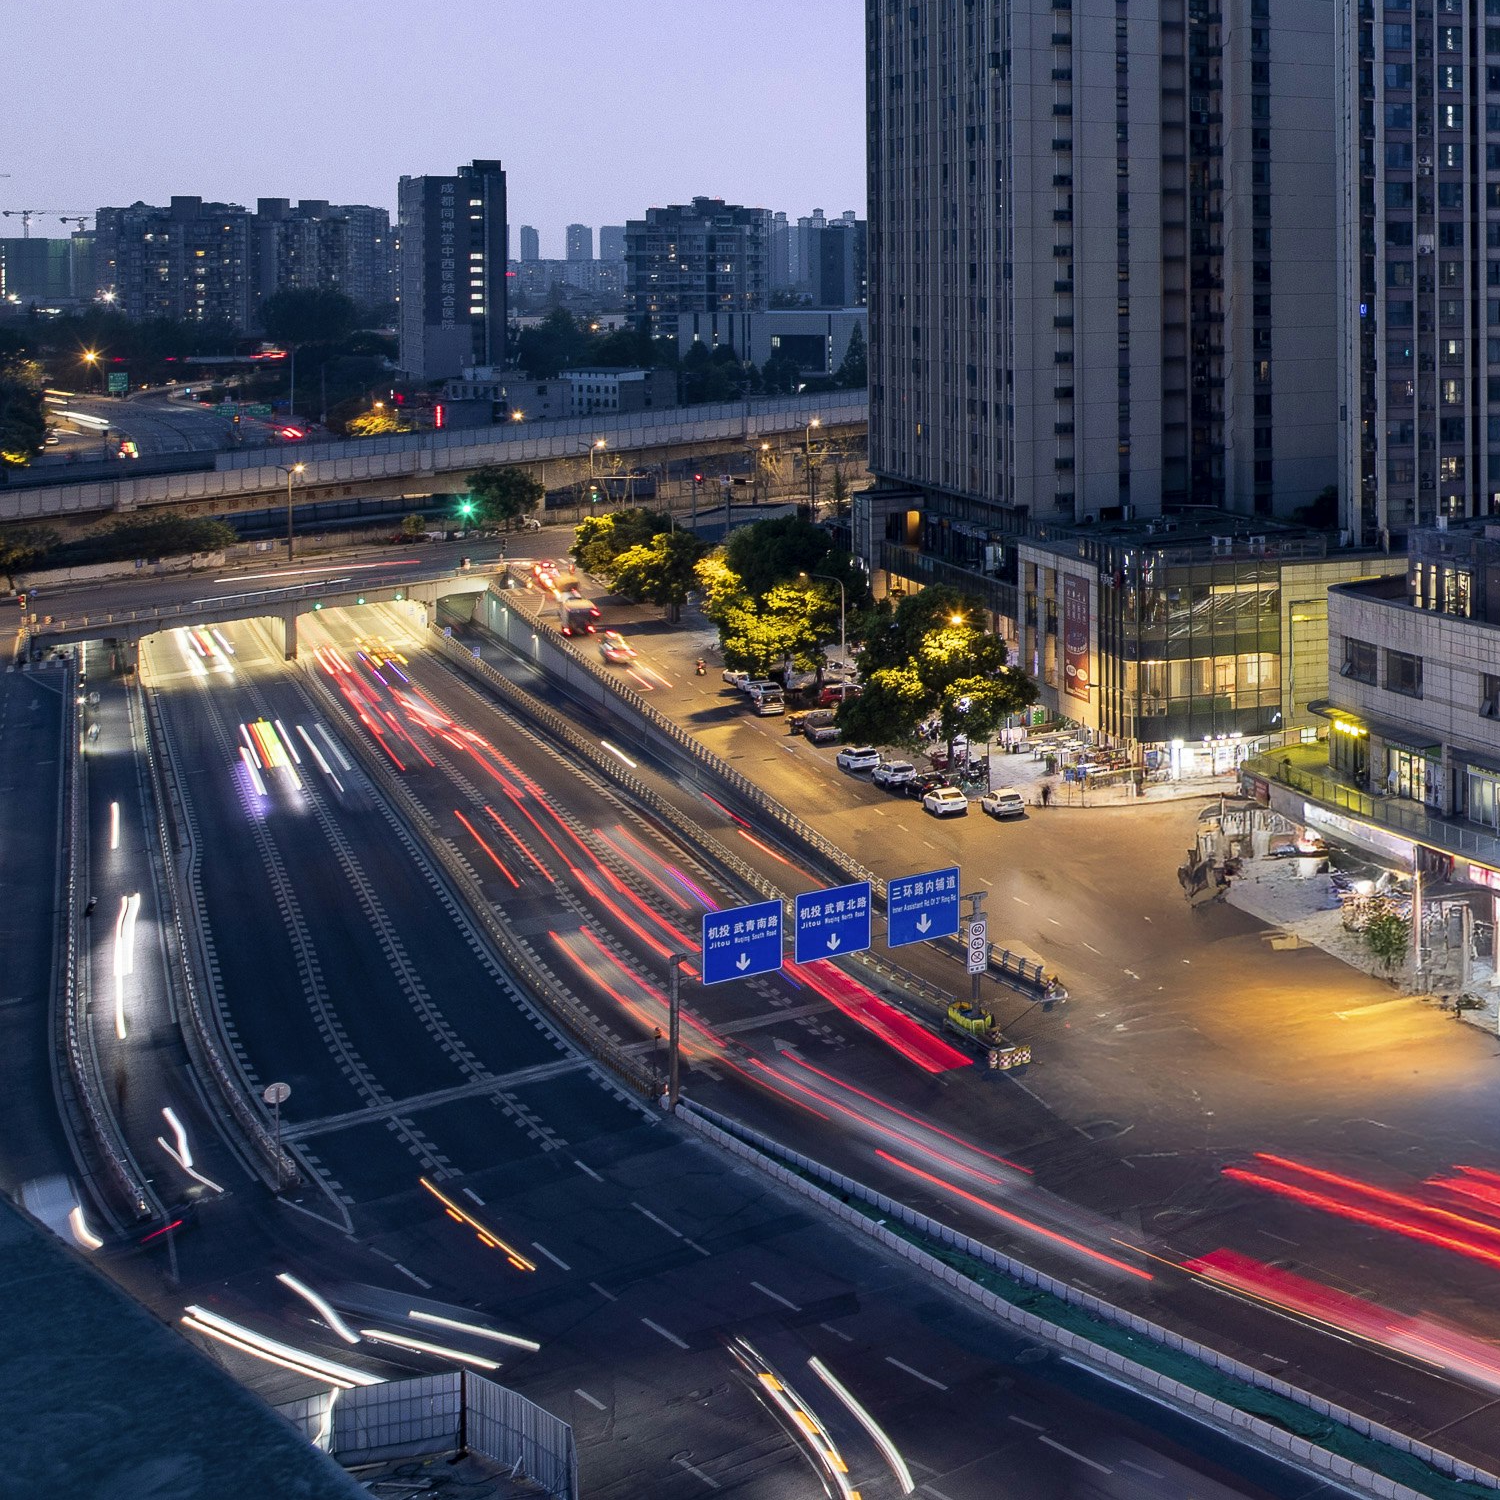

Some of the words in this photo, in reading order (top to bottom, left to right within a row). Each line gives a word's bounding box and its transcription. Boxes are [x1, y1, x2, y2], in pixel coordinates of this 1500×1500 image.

[891, 875, 956, 901] 三环路内辅道
[800, 905, 822, 920] 机投
[824, 896, 867, 915] 武青北路
[707, 924, 731, 940] 机投
[733, 915, 778, 934] 武青南路
[801, 920, 822, 930] Jitou
[709, 940, 731, 950] Jitou
